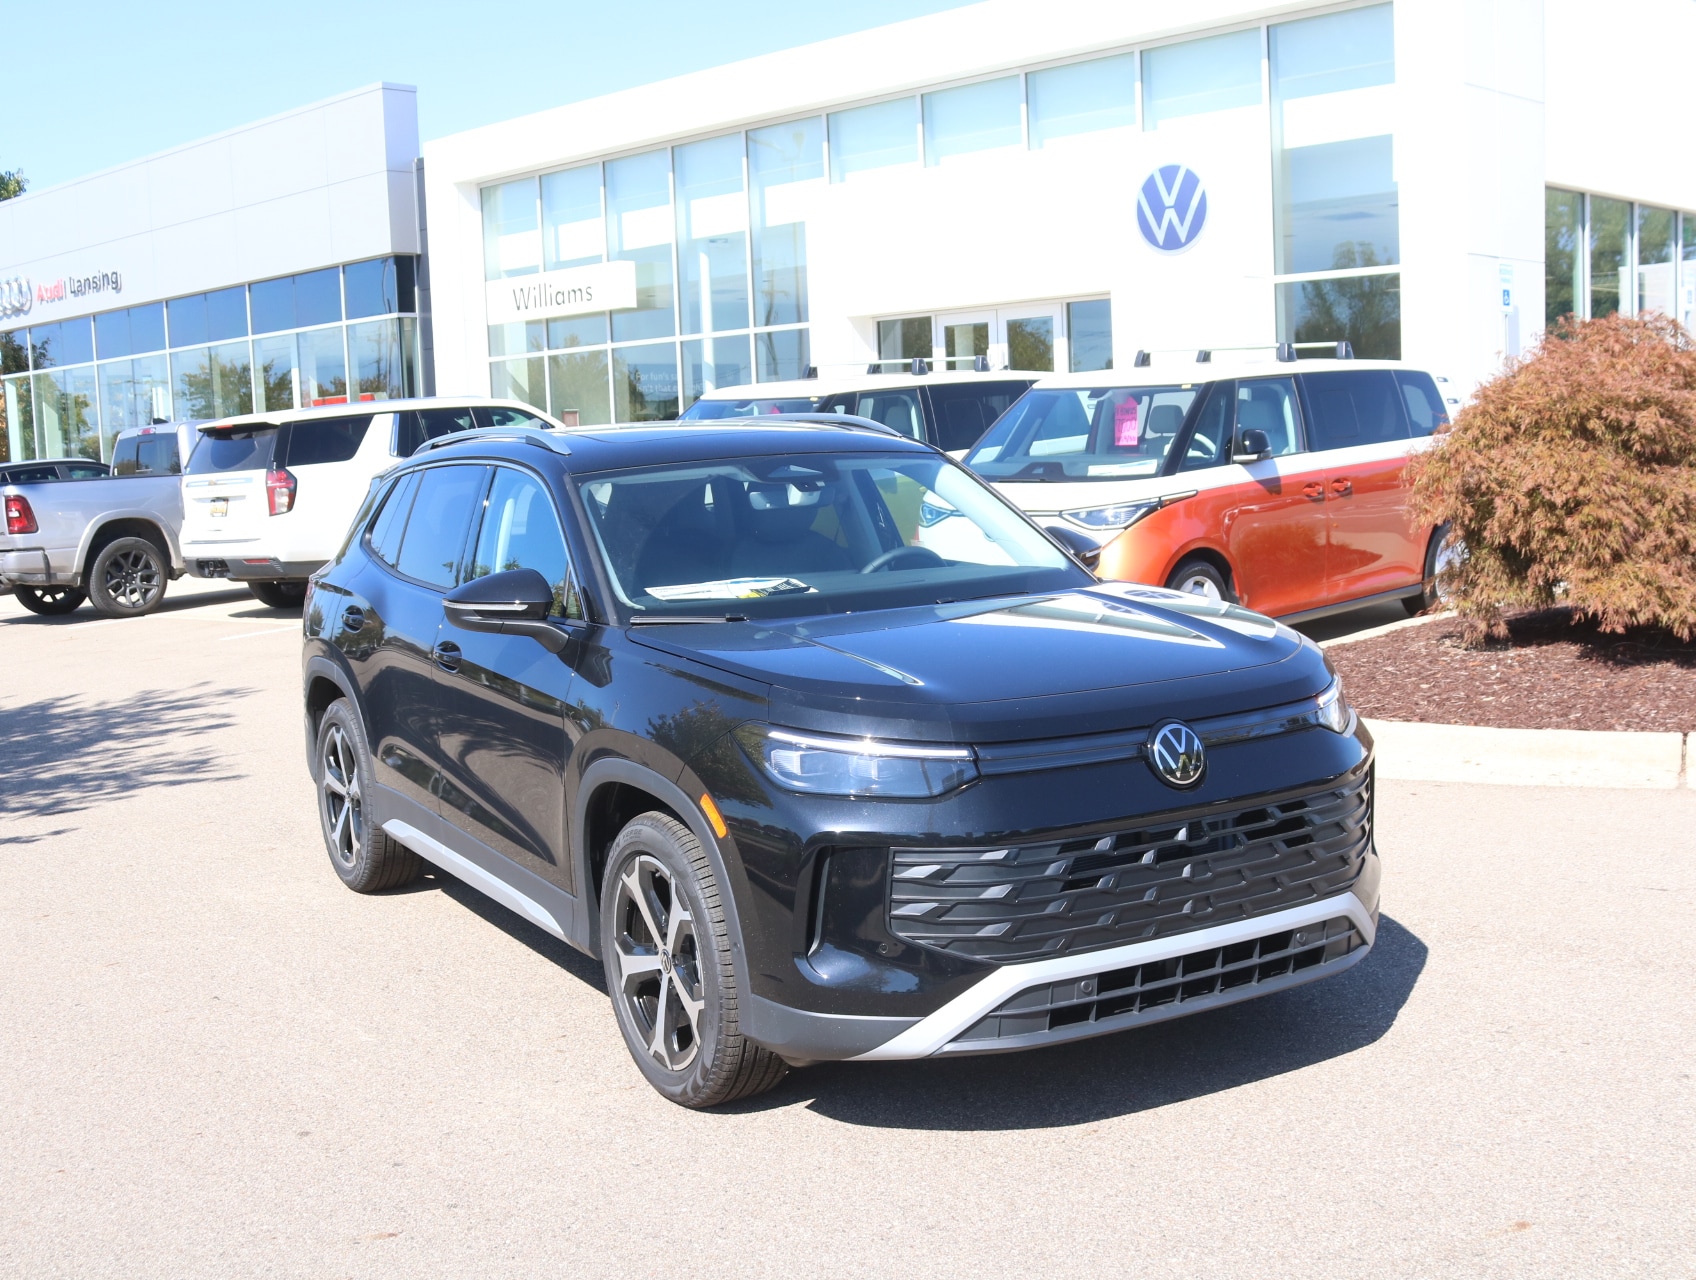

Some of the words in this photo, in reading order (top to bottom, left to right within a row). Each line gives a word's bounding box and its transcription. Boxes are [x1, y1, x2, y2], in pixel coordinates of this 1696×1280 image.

[37, 279, 64, 302] Audi
[69, 270, 120, 294] Lansing
[512, 282, 593, 311] Williams
